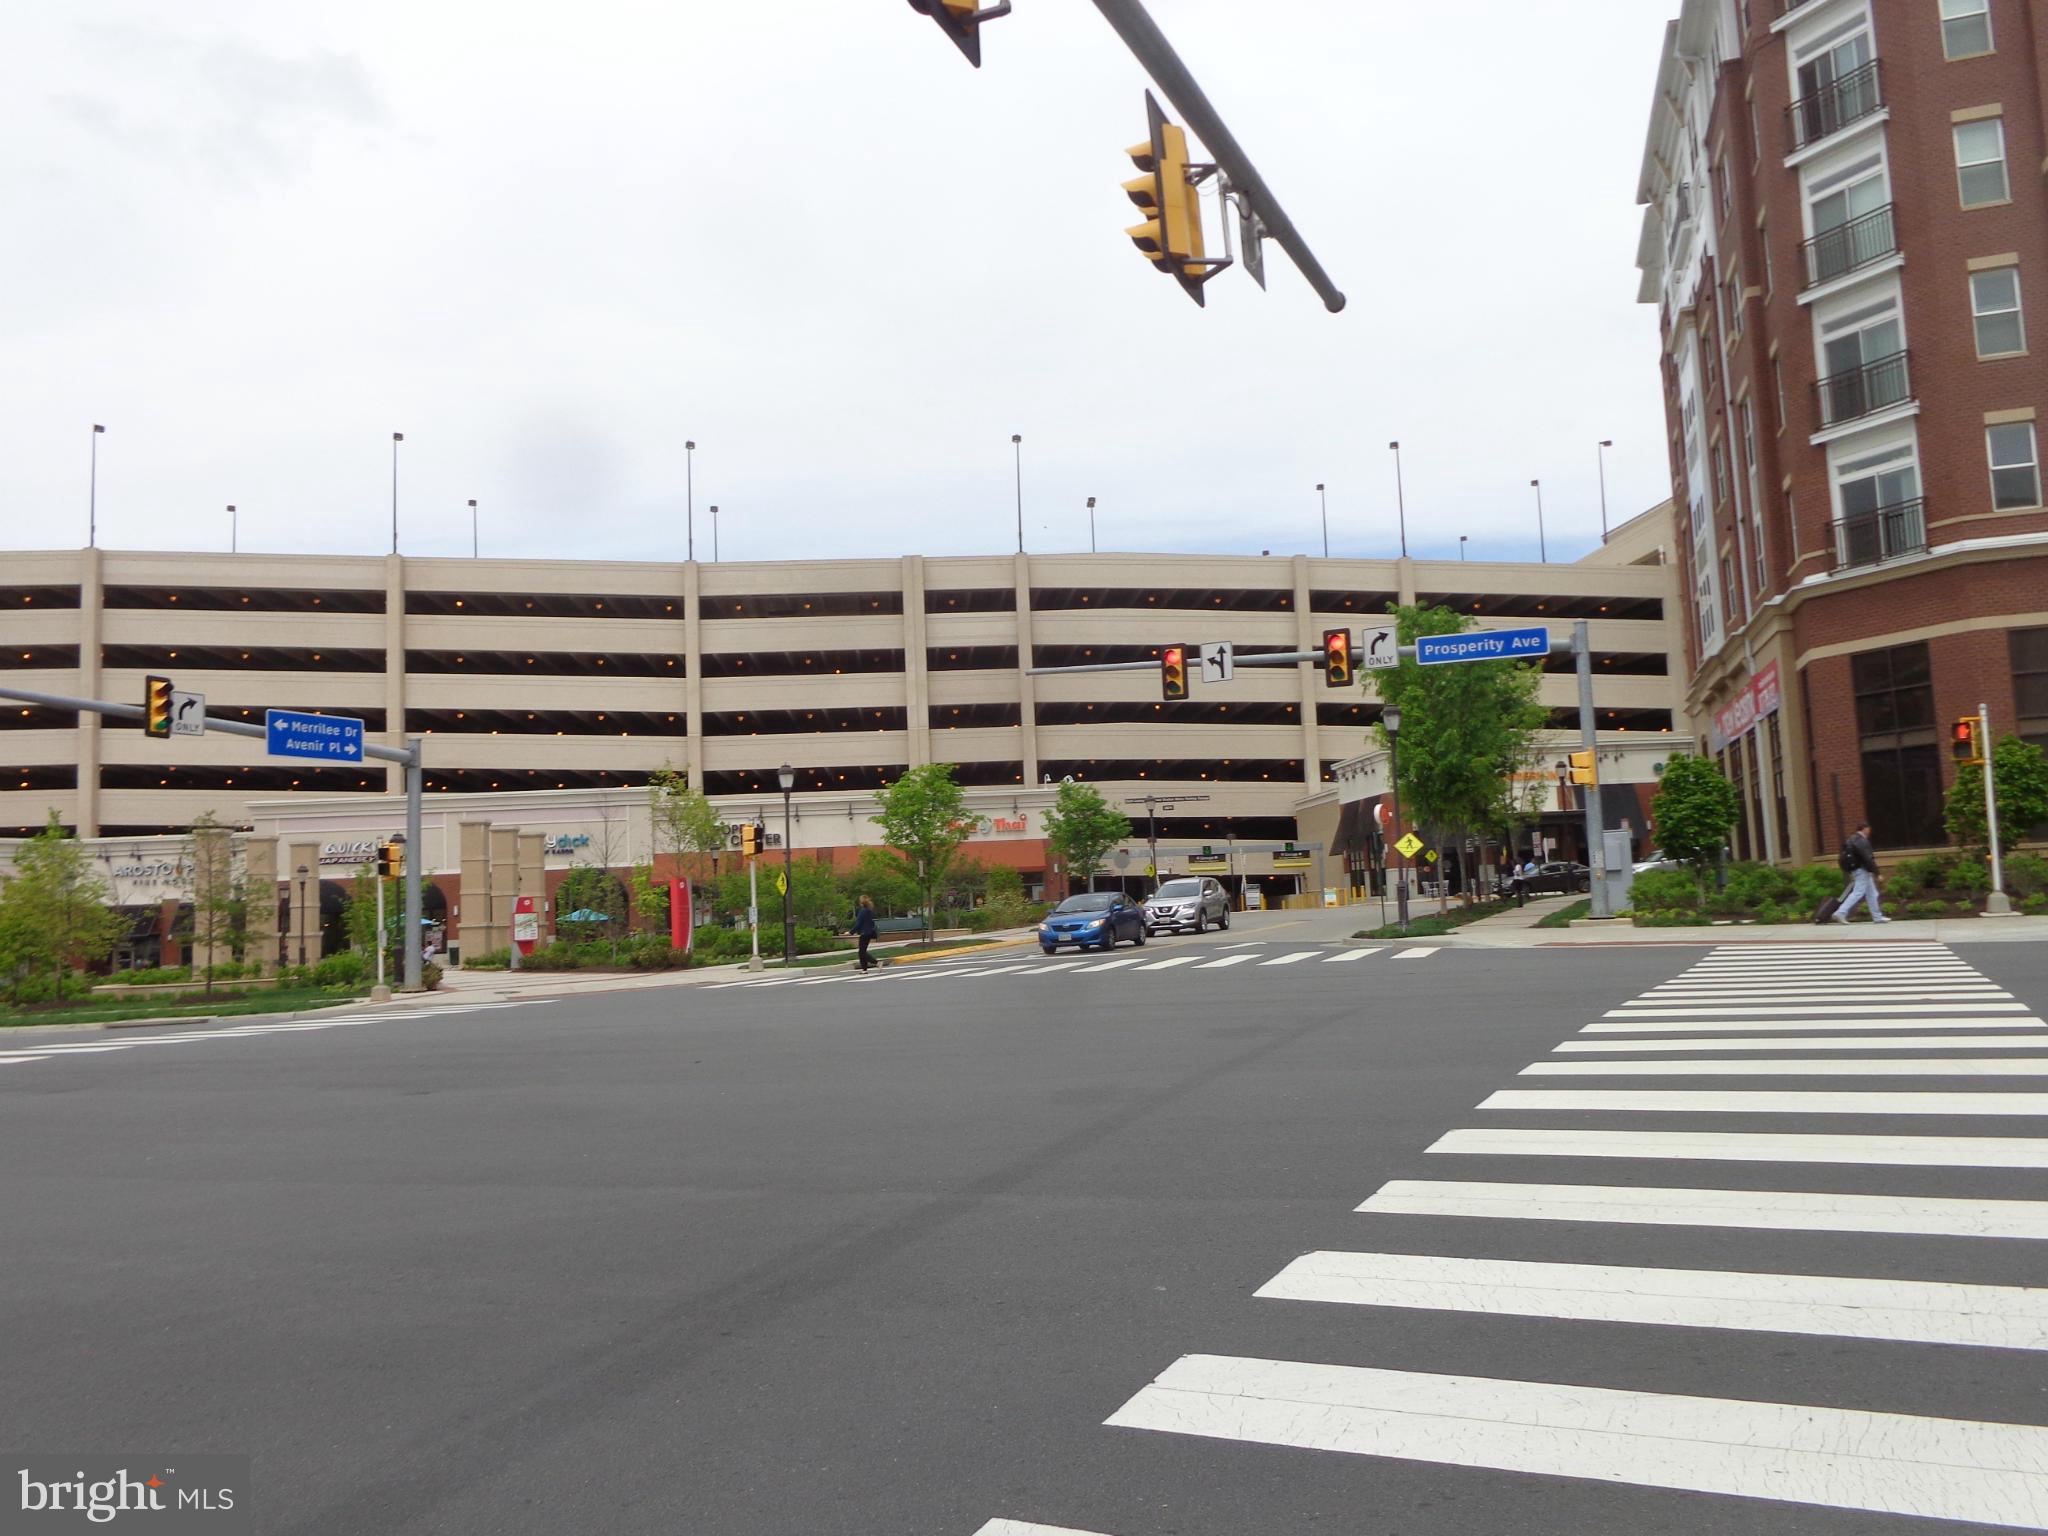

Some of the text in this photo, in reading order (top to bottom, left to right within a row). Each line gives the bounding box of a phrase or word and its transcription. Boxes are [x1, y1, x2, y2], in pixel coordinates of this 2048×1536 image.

[1424, 635, 1541, 656] Prosperity Ave
[1368, 655, 1394, 665] ONLY
[175, 722, 201, 733] ONLY
[291, 721, 358, 737] Merrilee Dr
[286, 738, 341, 753] Avenir Pl
